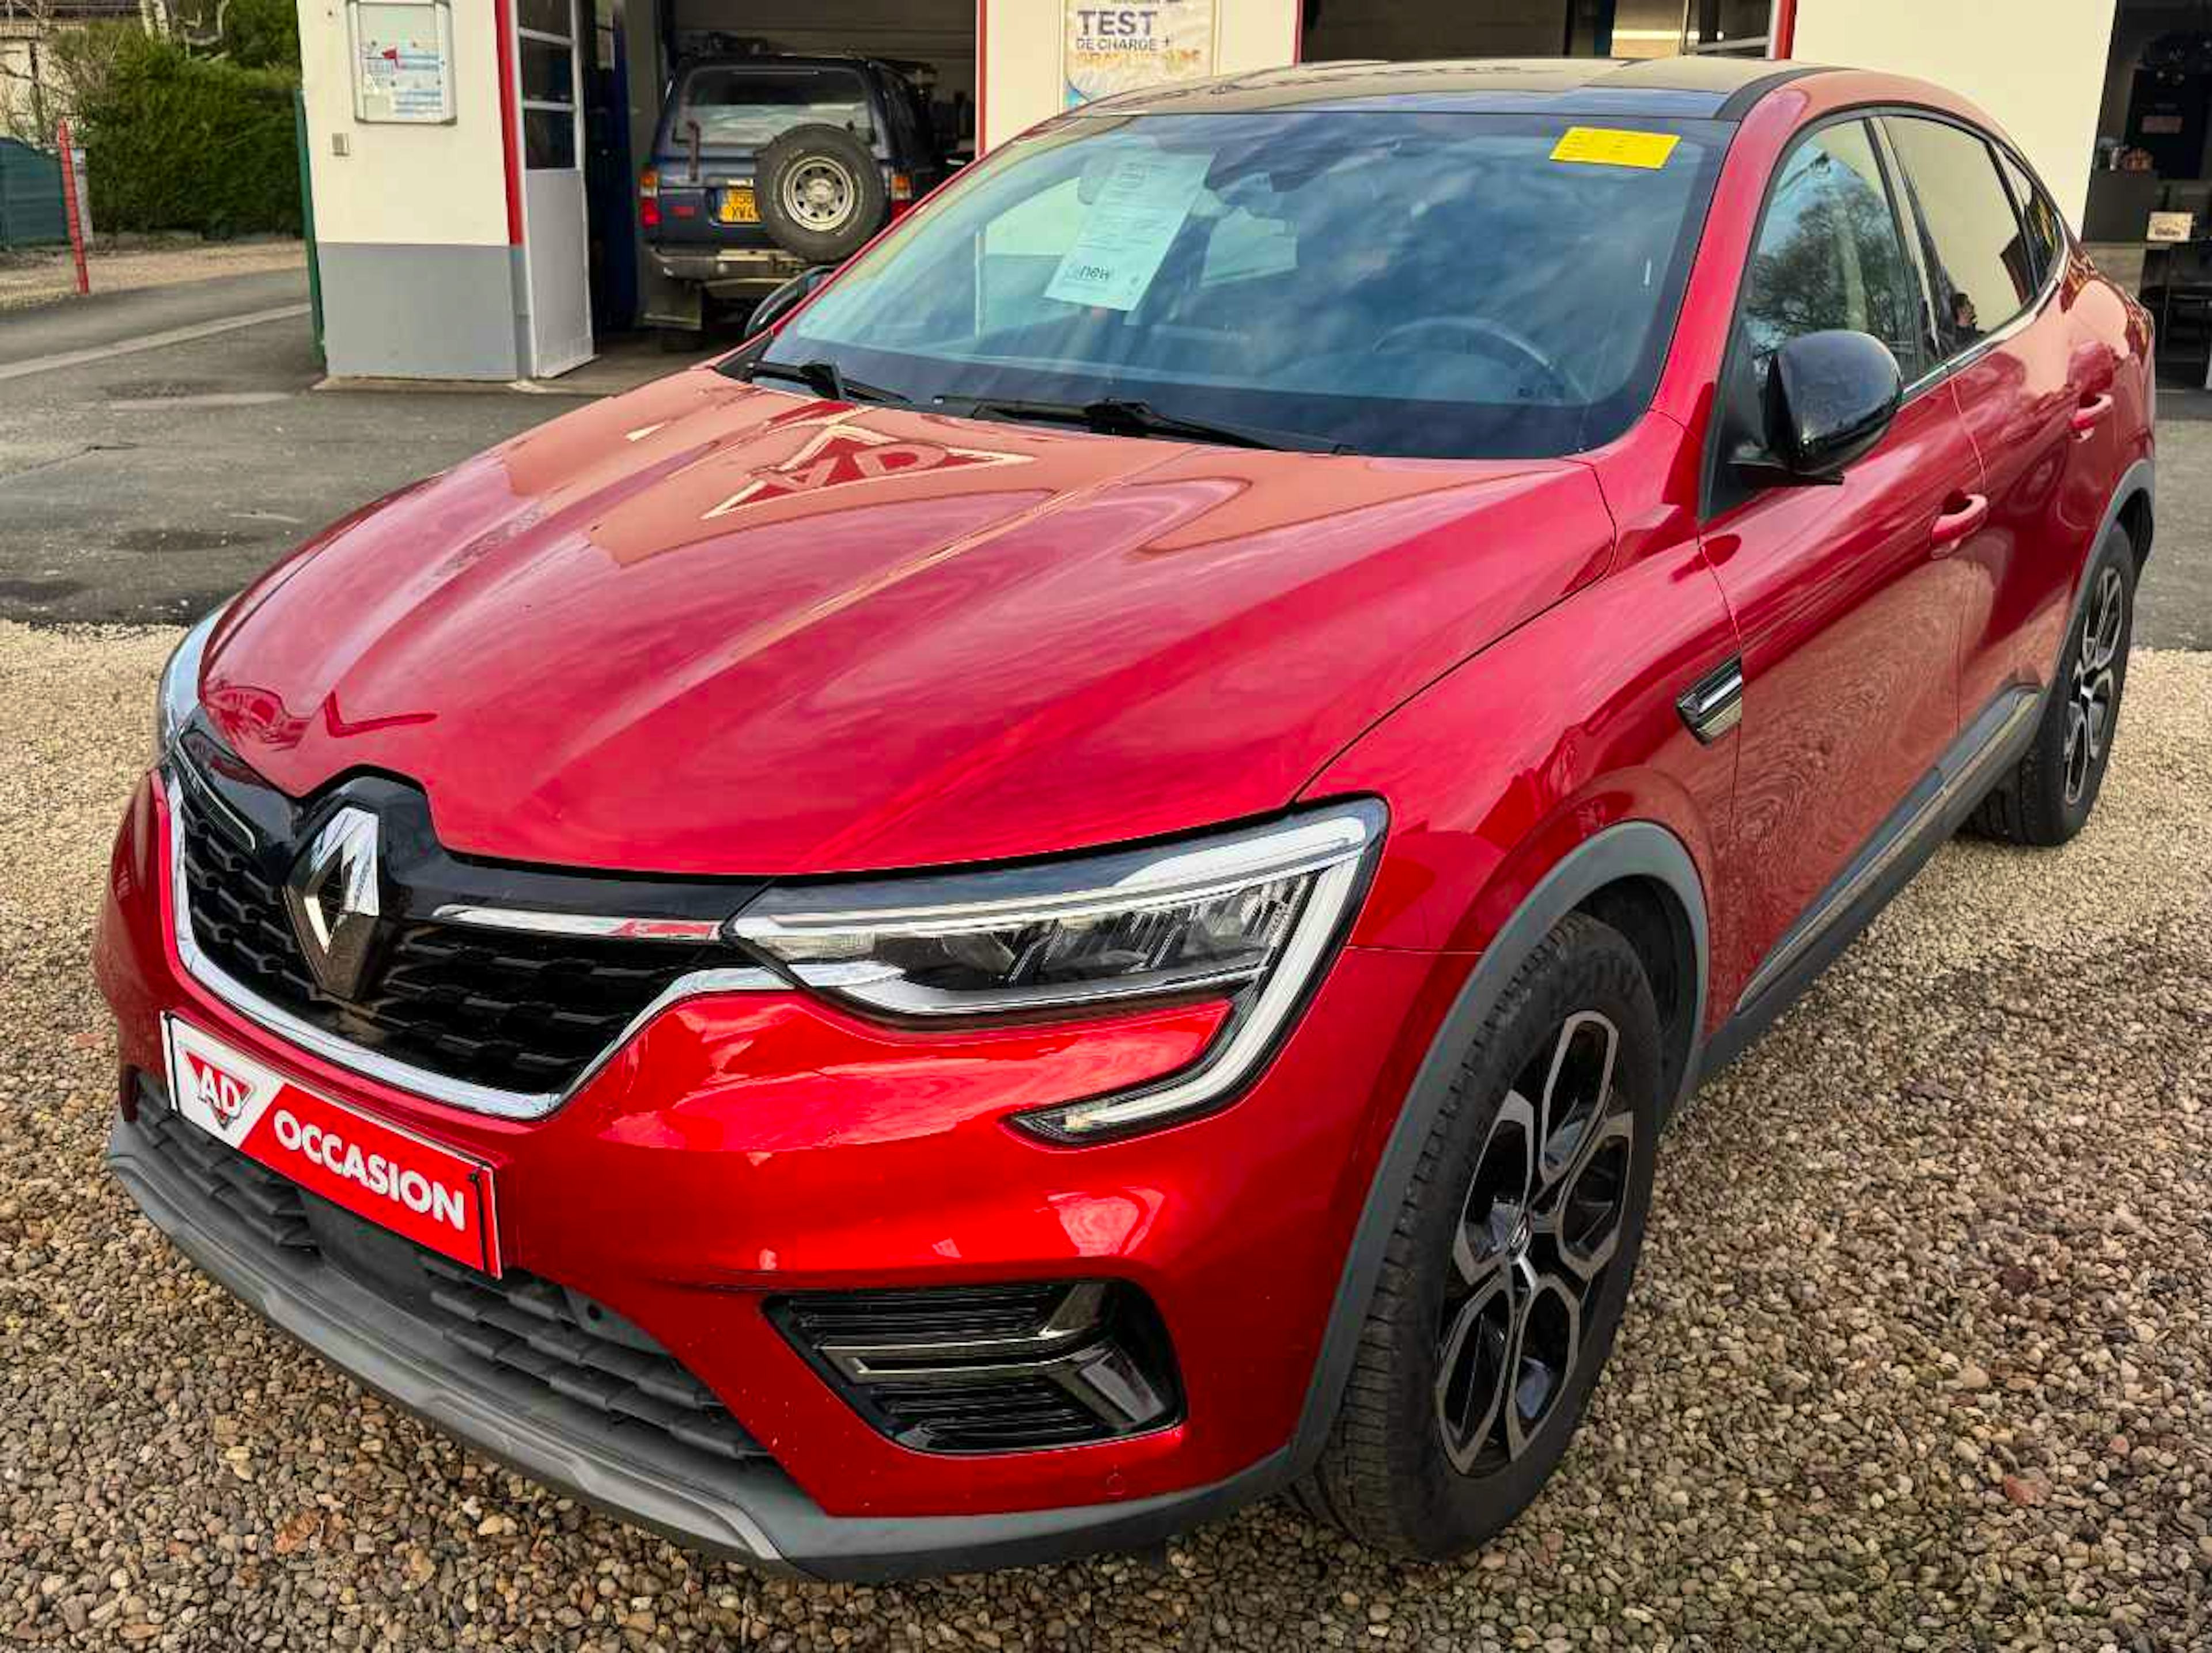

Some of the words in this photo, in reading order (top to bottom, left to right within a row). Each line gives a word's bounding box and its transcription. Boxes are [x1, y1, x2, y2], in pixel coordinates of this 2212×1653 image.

[1077, 10, 1158, 36] TEST
[1077, 38, 1094, 51] DE
[1095, 38, 1158, 51] CHARGE
[197, 1063, 242, 1119] AD
[273, 1109, 466, 1231] OCCASION
